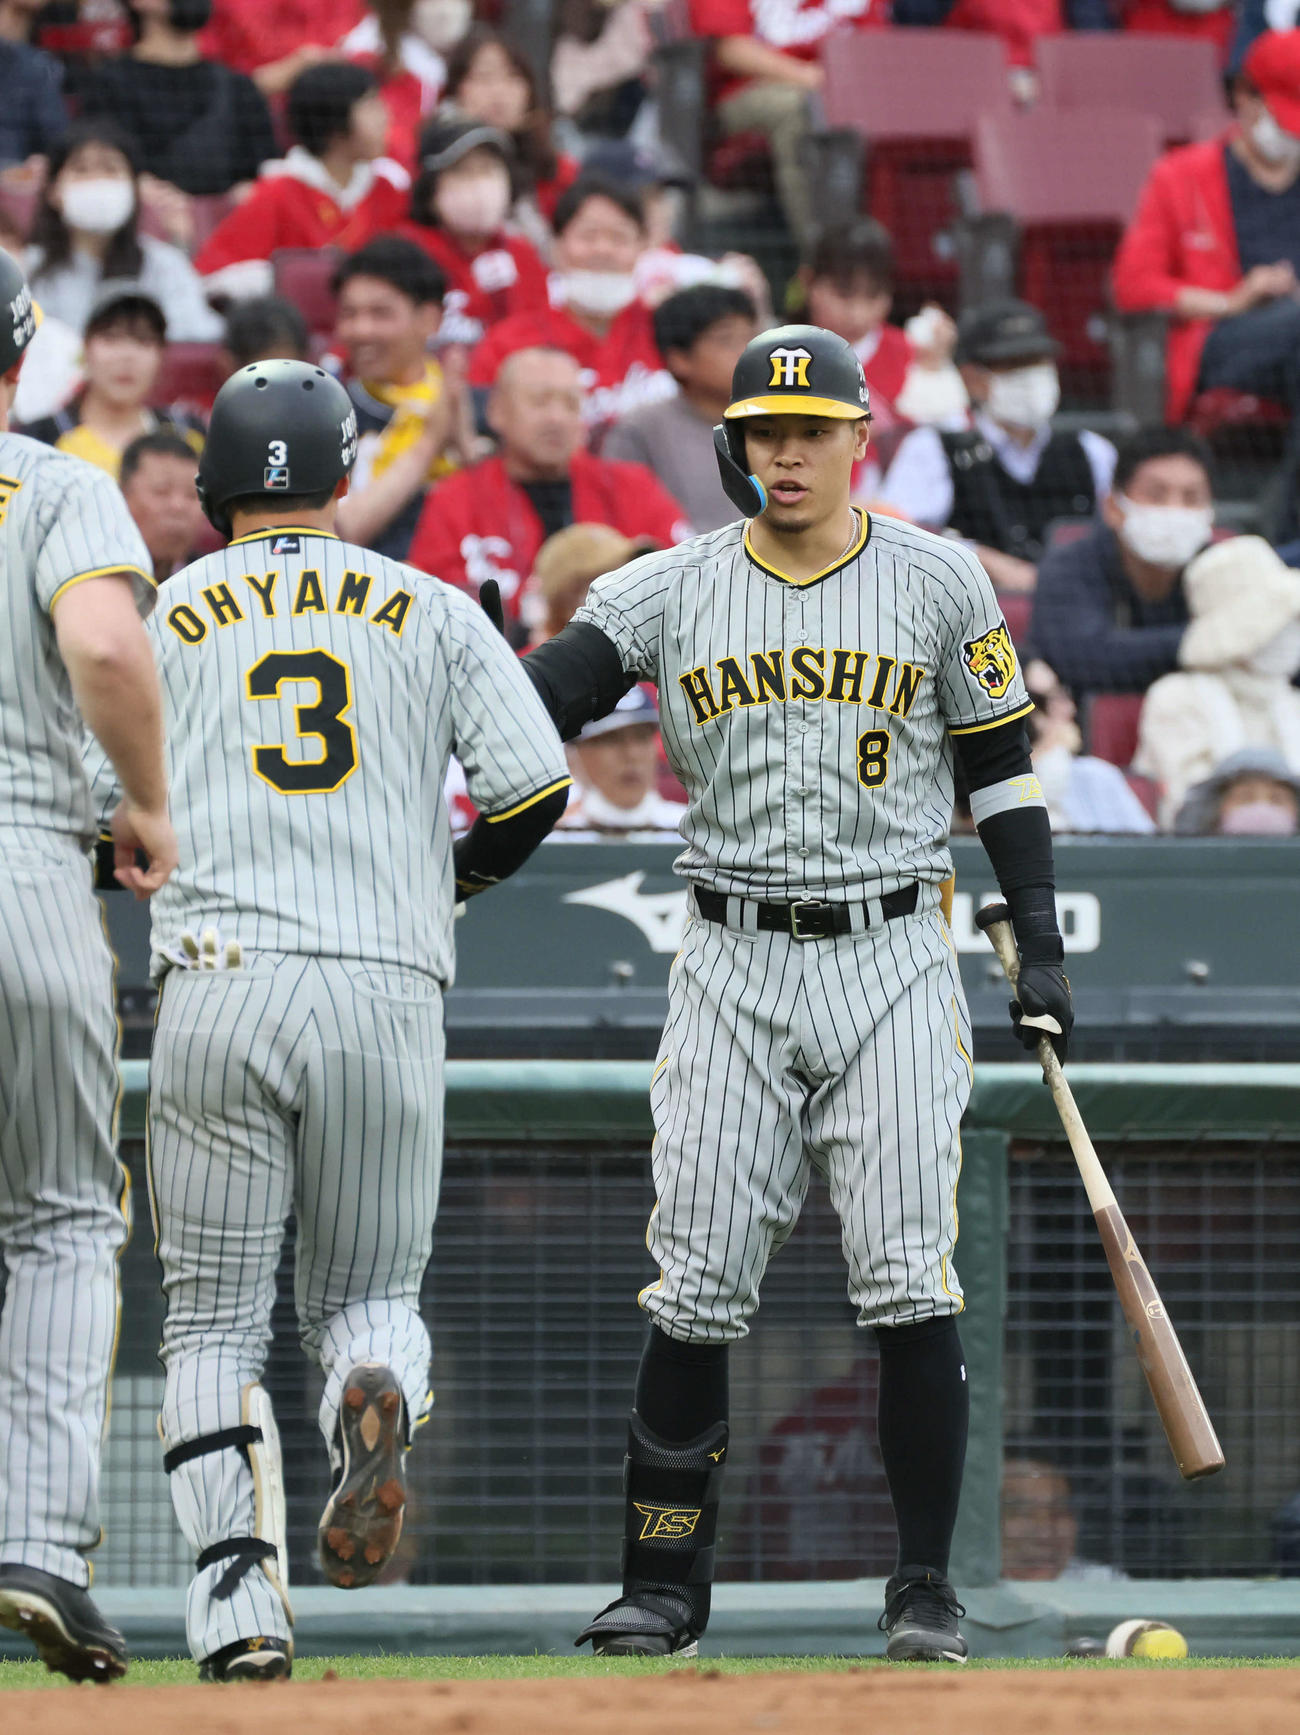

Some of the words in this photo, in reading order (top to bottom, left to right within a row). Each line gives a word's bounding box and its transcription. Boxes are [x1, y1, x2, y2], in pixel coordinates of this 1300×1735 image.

[268, 440, 288, 466] 3
[166, 568, 416, 646] OHYAMA
[678, 645, 926, 727] HANSHIN
[244, 647, 360, 796] 3
[857, 728, 892, 790] 8
[632, 1501, 702, 1541] TS
